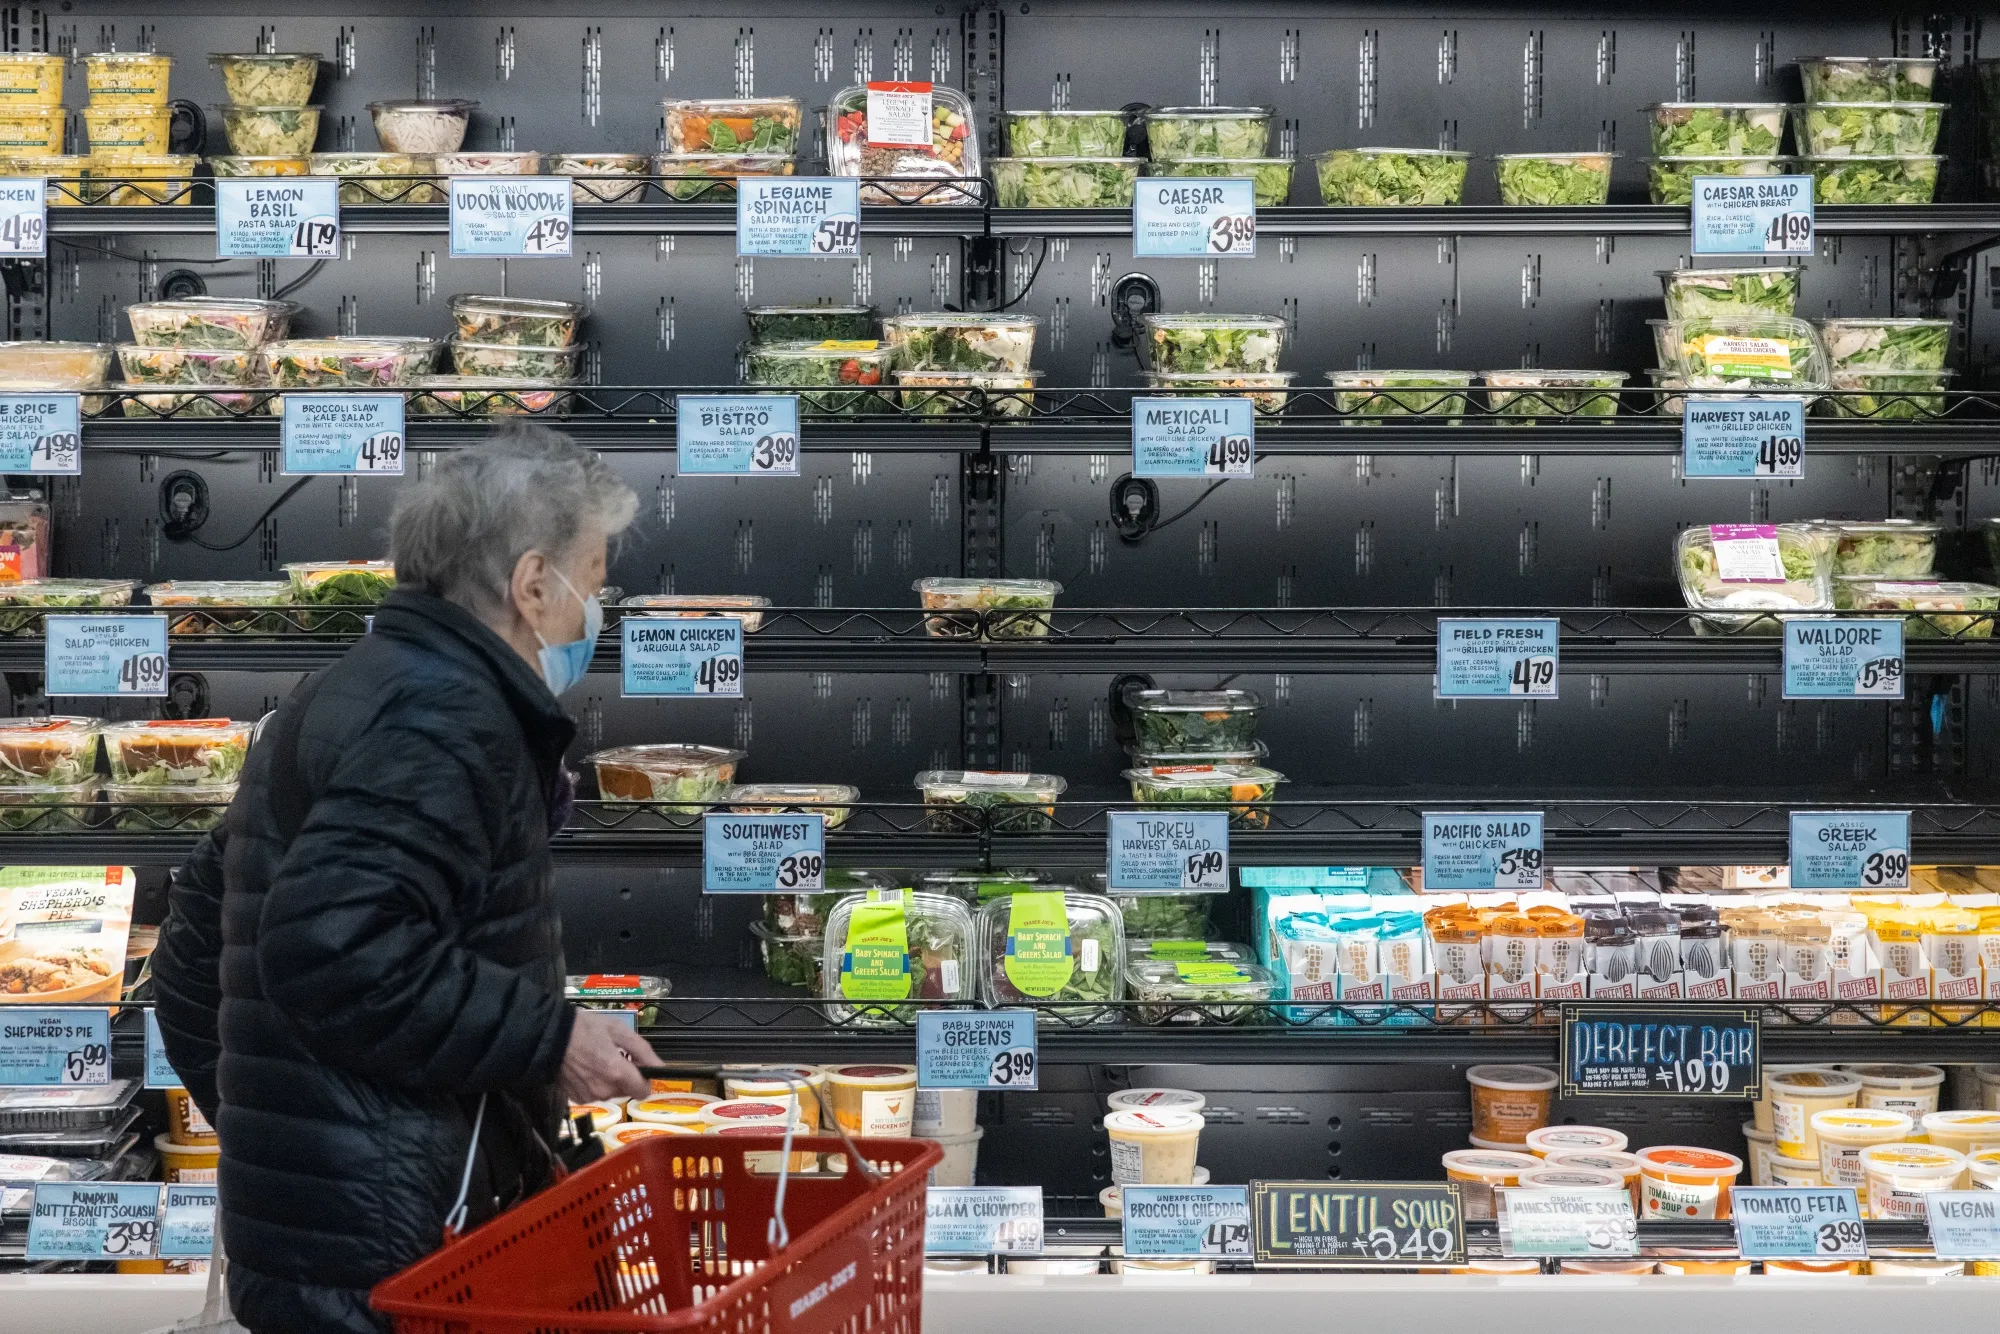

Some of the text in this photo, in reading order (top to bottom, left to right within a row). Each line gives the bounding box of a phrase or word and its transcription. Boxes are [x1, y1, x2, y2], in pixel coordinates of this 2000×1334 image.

[247, 189, 303, 201] LEMON
[490, 185, 528, 194] PEANUT
[760, 187, 832, 199] LEGUME
[1704, 184, 1798, 200] CAESAR SALAD
[457, 193, 564, 211] UDON NOODLE
[1159, 188, 1224, 204] CAESAR
[754, 201, 826, 214] SPINACH
[1723, 200, 1758, 208] CHICKEN
[1761, 199, 1792, 207] BREAST
[250, 203, 297, 217] BASIL
[493, 211, 516, 219] SALAD
[1175, 206, 1207, 215] SALAD
[270, 220, 296, 228] SALAD
[751, 216, 816, 224] SALAD PALETTE
[15, 404, 57, 414] SPICE
[302, 404, 379, 413] BROCCOLI SLAW
[314, 414, 338, 422] KALE
[701, 412, 769, 426] BISTRO
[1146, 409, 1228, 425] MEXICALI
[1692, 411, 1790, 423] HARVEST SALAD
[720, 427, 754, 436] SALAD
[1168, 426, 1206, 434] SALAD
[1722, 423, 1791, 431] GRILLED CHICKEN
[7, 431, 37, 440] SALAD
[81, 625, 124, 633] CHINESE
[1454, 629, 1543, 640] FIELD FRESH
[631, 629, 735, 642] LEMON CHICKEN
[1797, 629, 1881, 645] WALDORF
[65, 639, 149, 649] SALAD CHICKEN
[643, 643, 720, 652] ARUGULA SALAD
[1819, 646, 1852, 656] SALAD
[723, 824, 809, 840] SOUTHWEST
[1137, 822, 1194, 839] TURKEY
[1434, 823, 1530, 839] PACIFIC SALAD
[1818, 828, 1877, 842] GREEK
[753, 841, 783, 850] SALAD
[1123, 839, 1210, 850] HARVEST SALAD
[1459, 840, 1506, 849] CHICKEN
[1828, 842, 1866, 851] SALAD
[46, 889, 82, 897] VEGAN
[20, 896, 105, 911] SHEPHERD'S
[48, 910, 74, 920] PIE
[1018, 932, 1061, 941] BABY SPINACH
[856, 949, 899, 957] BABY SPINACH
[1018, 951, 1062, 959] GREENS SALAD
[854, 967, 899, 976] GREENS SALAD
[1689, 978, 1728, 998] PERFECT BAR
[1838, 980, 1869, 999] PERFECT
[1887, 980, 1918, 999] PERFECT
[943, 1020, 1014, 1030] BABY SPINACH
[4, 1026, 92, 1039] SHEPHERD'S PIE
[944, 1031, 1011, 1045] GREENS
[1574, 1022, 1753, 1080] PERFECT BAR
[1832, 1157, 1861, 1170] VEGAN
[73, 1191, 119, 1205] PUMPKIN
[1648, 1186, 1700, 1203] TOMATO FETA
[926, 1203, 1037, 1217] CLAM CHOWDER
[1131, 1203, 1244, 1218] BROCCOLI CHEDDAR
[1514, 1202, 1629, 1215] MINESTRONE SOUP
[1661, 1201, 1682, 1212] SOUP
[1741, 1196, 1847, 1214] TOMATO FETA
[1880, 1197, 1911, 1212] VEGAN
[1939, 1202, 1995, 1218] VEGAN
[63, 1218, 98, 1227] BISQUE
[1270, 1191, 1455, 1248] LENTIL SOUP
[1788, 1215, 1814, 1224] SOUP
